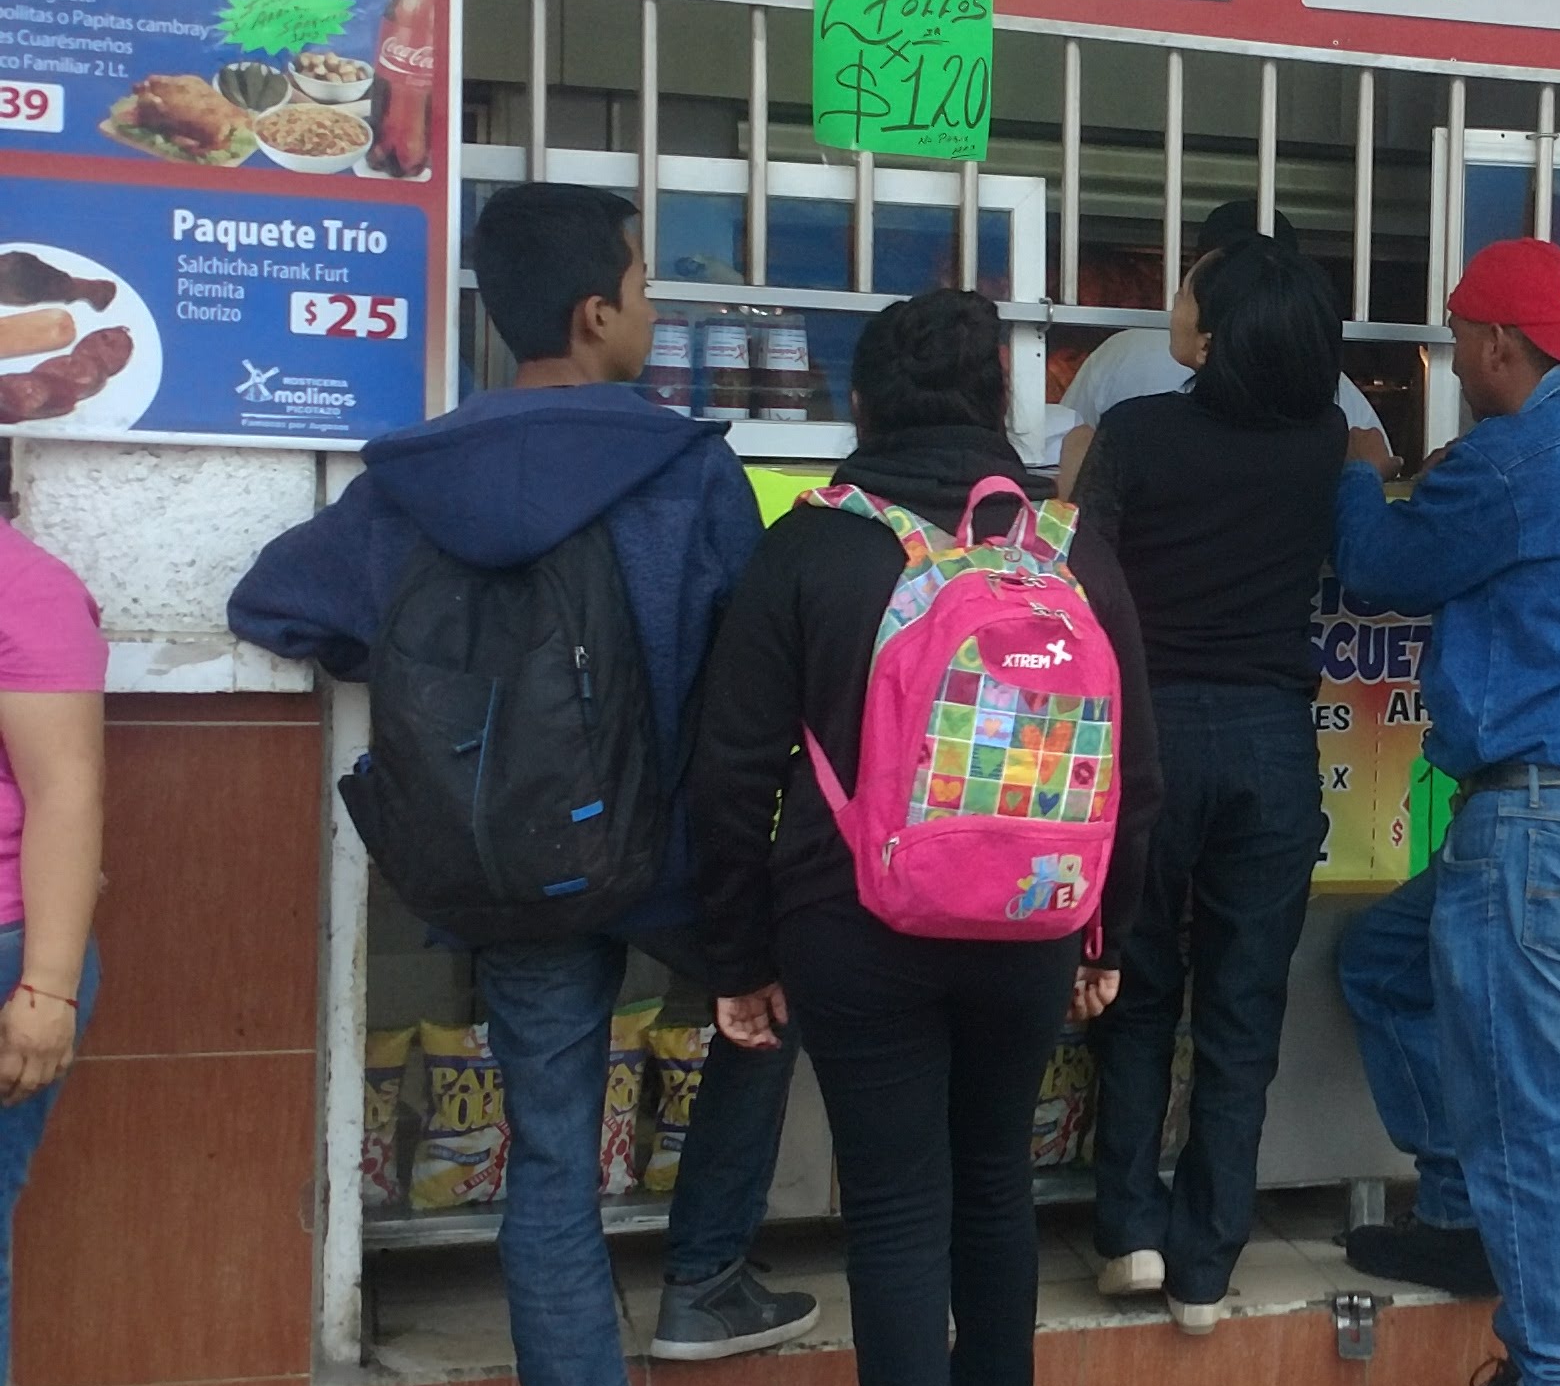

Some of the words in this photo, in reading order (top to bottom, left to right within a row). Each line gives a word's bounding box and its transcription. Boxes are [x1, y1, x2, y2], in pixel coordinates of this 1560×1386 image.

[57, 12, 69, 25] o
[72, 10, 134, 31] Papitas
[136, 18, 211, 40] cambray
[23, 53, 91, 75] Familiar
[94, 60, 105, 77] 2
[173, 209, 316, 253] Paquete
[322, 219, 388, 254] Trío
[177, 254, 259, 278] Salchicha
[263, 260, 311, 281] Frank
[315, 263, 349, 283] Furt
[177, 278, 245, 300] Piernita
[176, 300, 242, 323] Chorizo
[273, 387, 357, 407] molinos
[1002, 653, 1051, 670] XTREM
